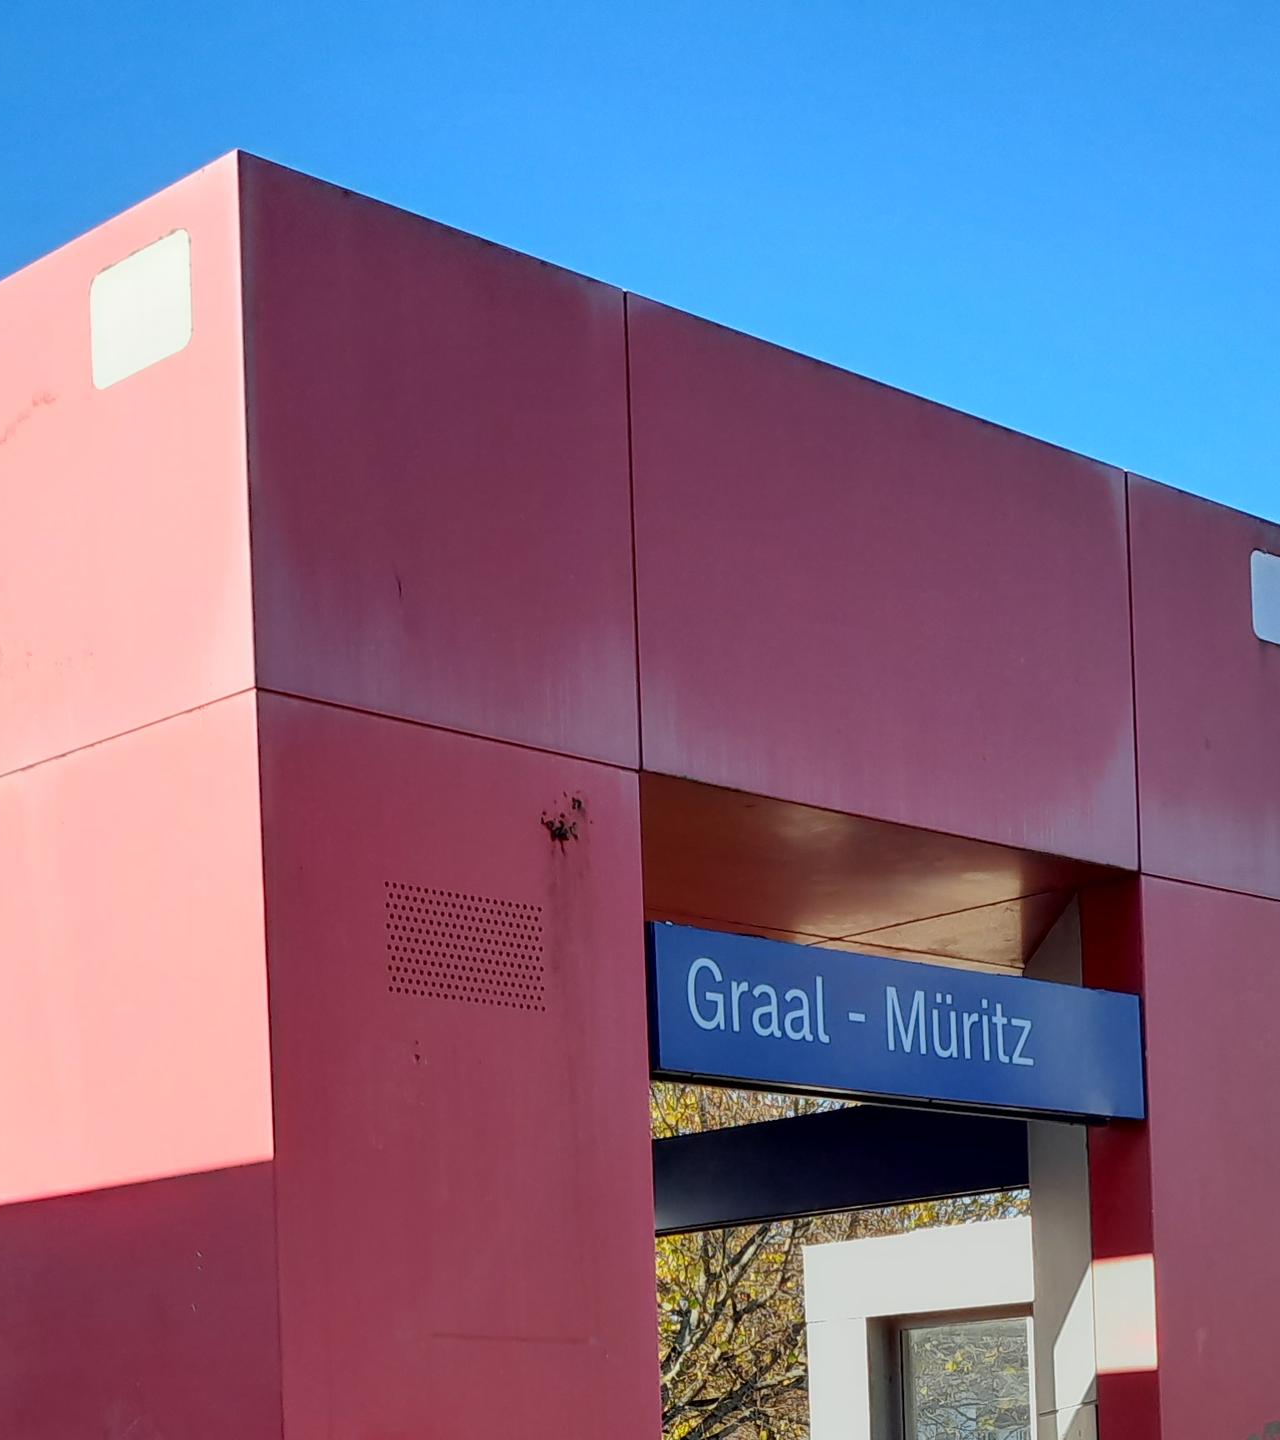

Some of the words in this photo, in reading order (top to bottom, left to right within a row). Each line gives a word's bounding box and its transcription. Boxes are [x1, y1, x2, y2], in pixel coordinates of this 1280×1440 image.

[686, 957, 830, 1044] Graal
[848, 1010, 866, 1024] -
[885, 985, 1035, 1067] Müritz
